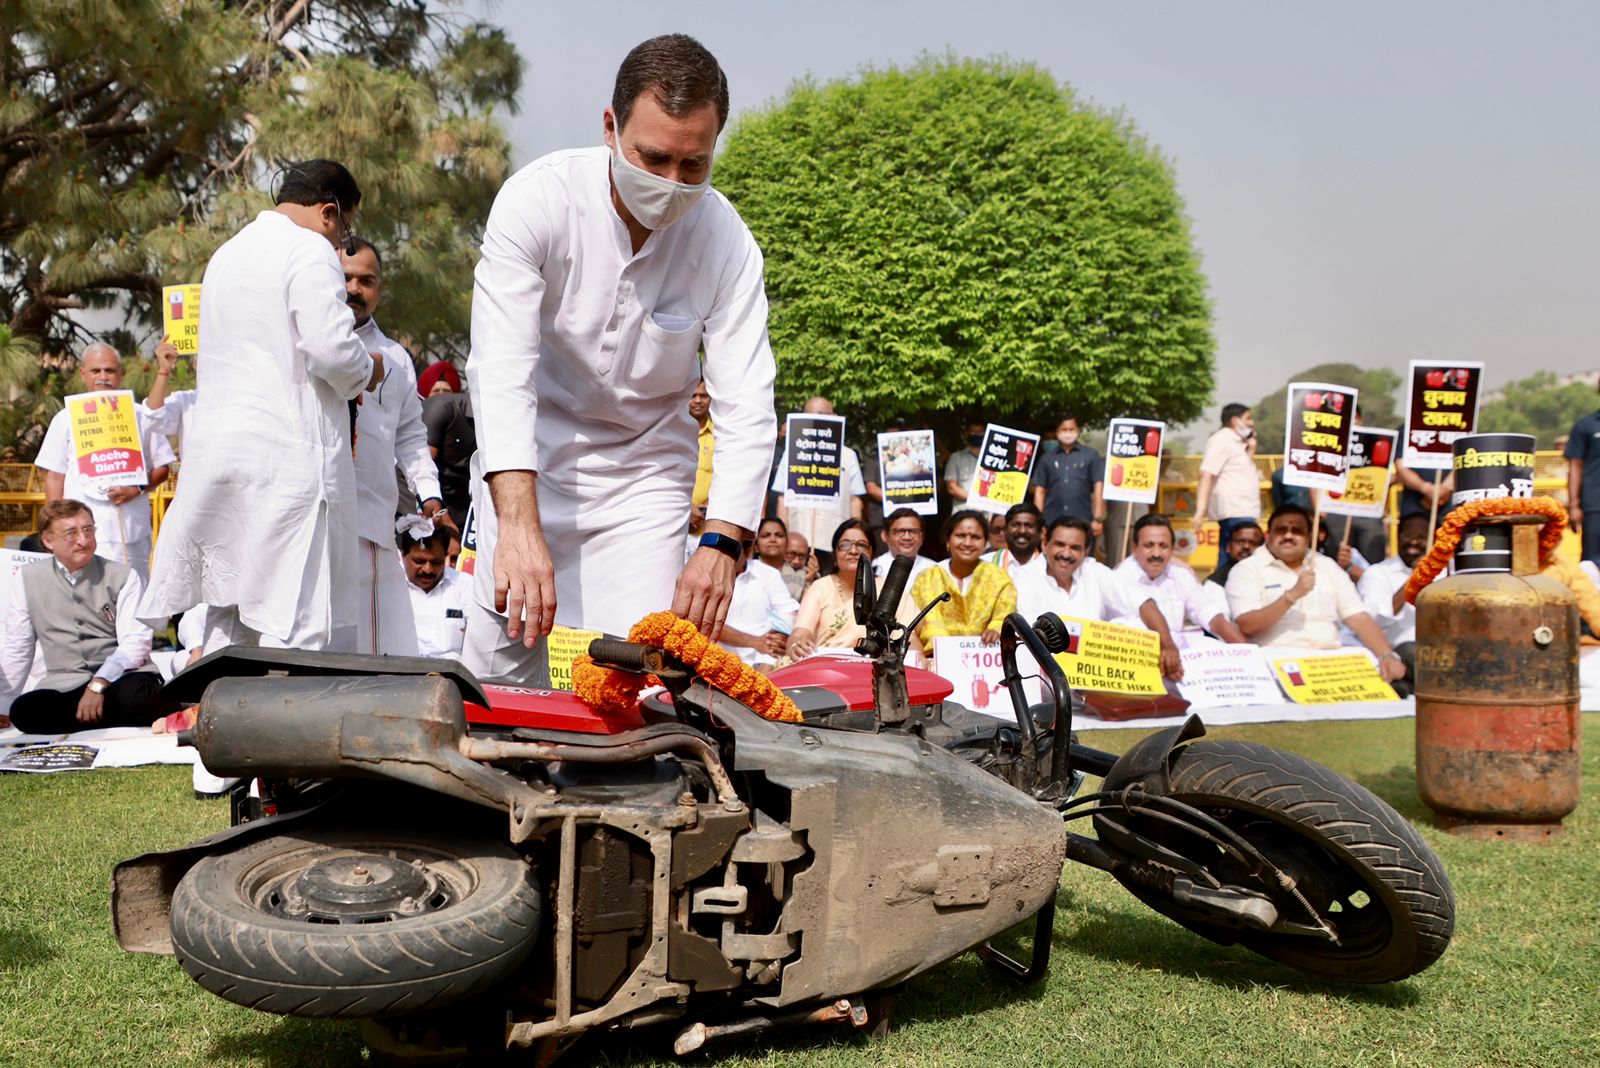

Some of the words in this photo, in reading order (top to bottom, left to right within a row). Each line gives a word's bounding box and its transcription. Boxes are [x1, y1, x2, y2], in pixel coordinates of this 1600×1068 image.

[184, 324, 198, 336] RO
[1423, 390, 1467, 408] चुनाव
[78, 416, 100, 425] DIESEL
[1302, 410, 1342, 429] चुनाव
[80, 428, 103, 436] PETROL
[802, 428, 817, 436] कम
[81, 440, 94, 448] LPG
[1114, 433, 1139, 444] LPG
[90, 450, 130, 463] Acche
[1463, 448, 1507, 468] डीजल
[95, 460, 127, 473] Din??
[1130, 470, 1148, 478] LPG
[1351, 482, 1374, 491] LPG
[550, 646, 568, 654] Petrol
[1085, 641, 1102, 649] Petrol
[1104, 644, 1120, 652] hiked
[1084, 650, 1102, 658] Diesel
[1103, 653, 1118, 661] hiked
[1182, 652, 1202, 661] TOP
[552, 667, 572, 679] OLL
[1077, 662, 1104, 677] ROLL
[1107, 667, 1135, 680] BACK
[1068, 676, 1089, 686] UEL
[1092, 679, 1125, 690] PRICE
[1127, 684, 1153, 692] HIKE
